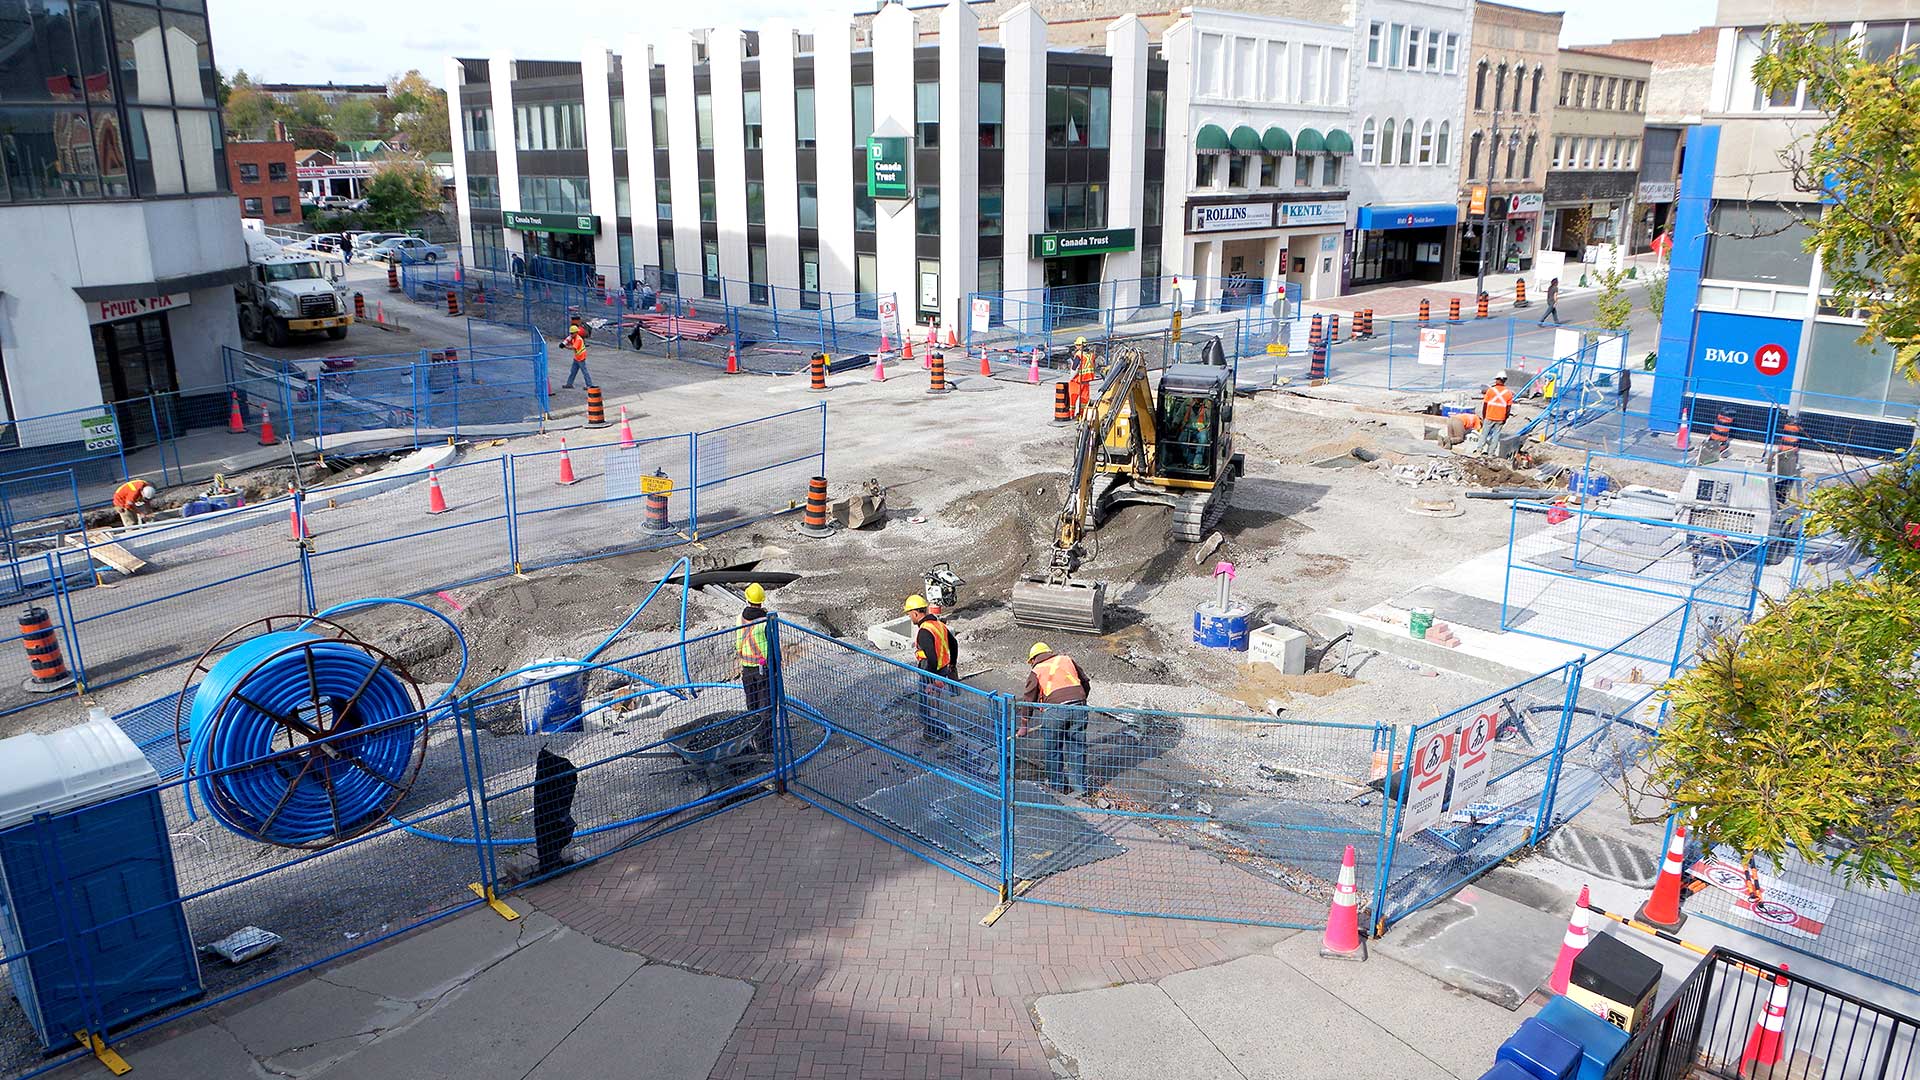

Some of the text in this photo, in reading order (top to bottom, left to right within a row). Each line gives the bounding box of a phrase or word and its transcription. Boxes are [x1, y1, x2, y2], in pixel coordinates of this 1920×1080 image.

[875, 162, 902, 171] Canada
[876, 172, 896, 181] Trust
[1206, 208, 1247, 221] ROLLINS
[1290, 205, 1322, 216] KENTE
[515, 216, 530, 224] Canada
[1060, 237, 1088, 247] Canada
[1089, 236, 1109, 245] Trust
[1705, 348, 1749, 365] BMO
